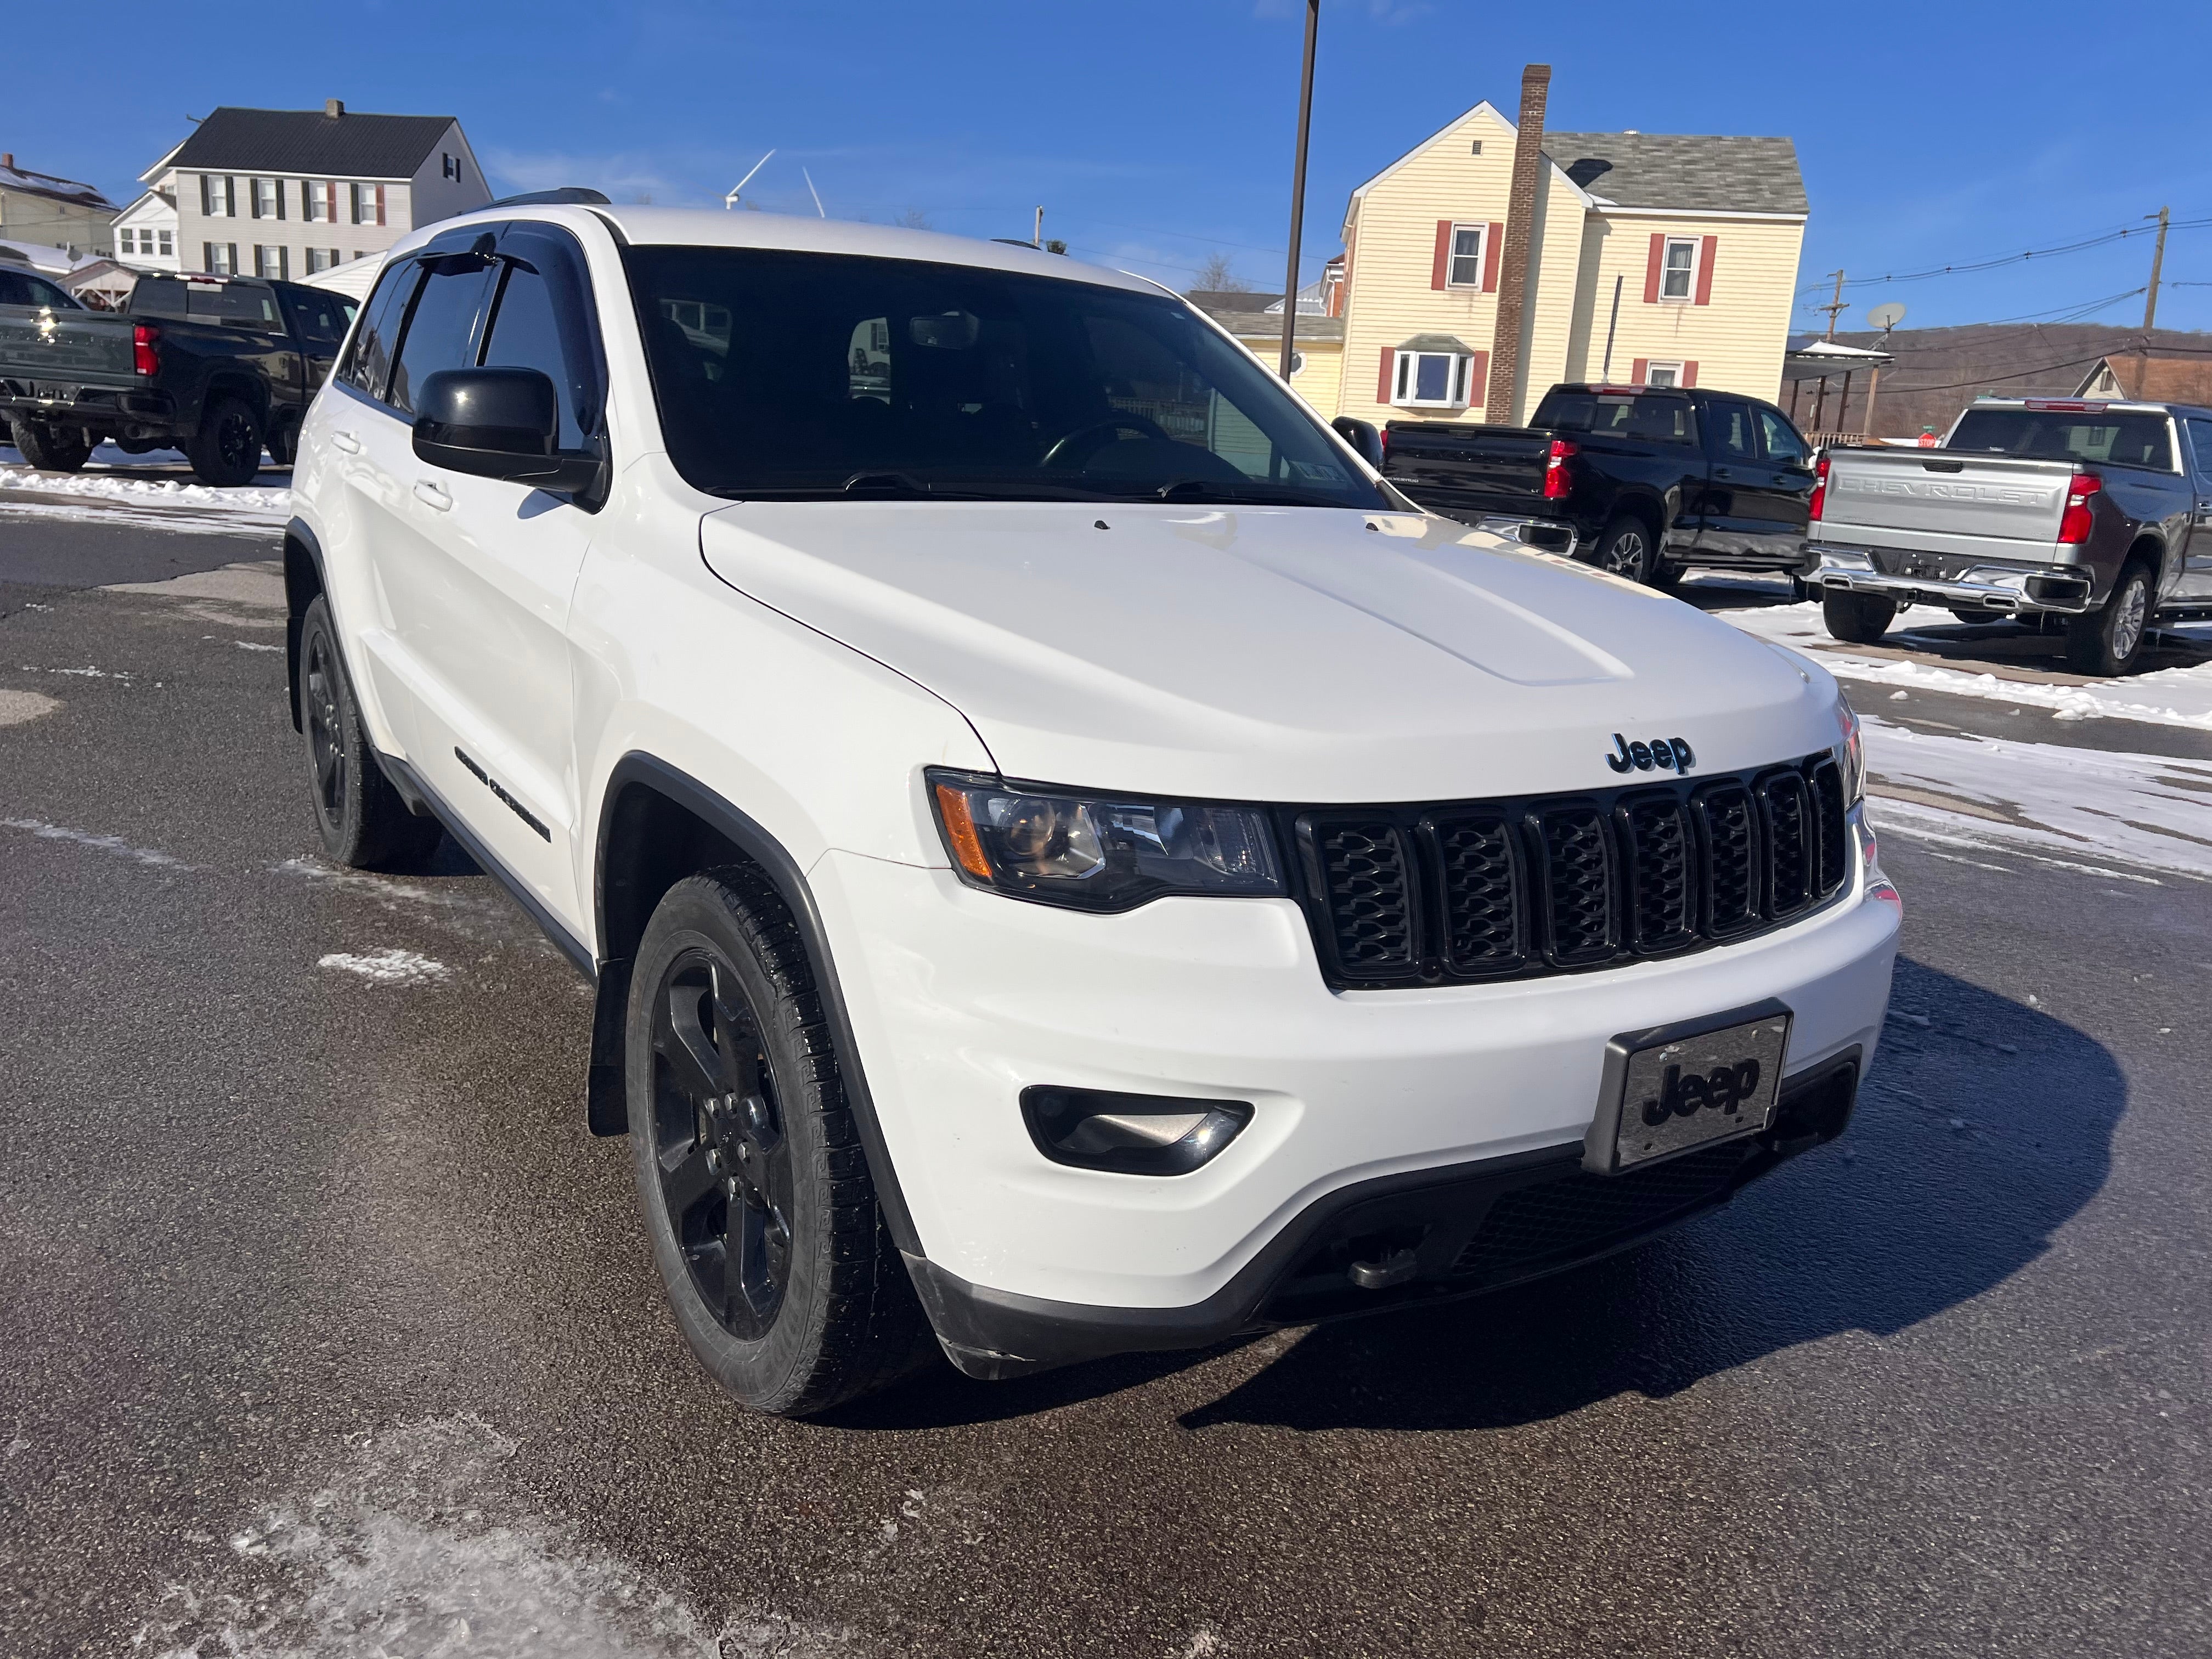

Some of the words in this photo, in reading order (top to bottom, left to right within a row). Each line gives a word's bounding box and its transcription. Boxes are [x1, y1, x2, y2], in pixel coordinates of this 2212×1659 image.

[1920, 438, 1935, 447] STOP
[1838, 477, 2047, 504] CHEVROLET
[1605, 733, 1694, 775] Jeep
[1641, 1058, 1760, 1126] Jeep
